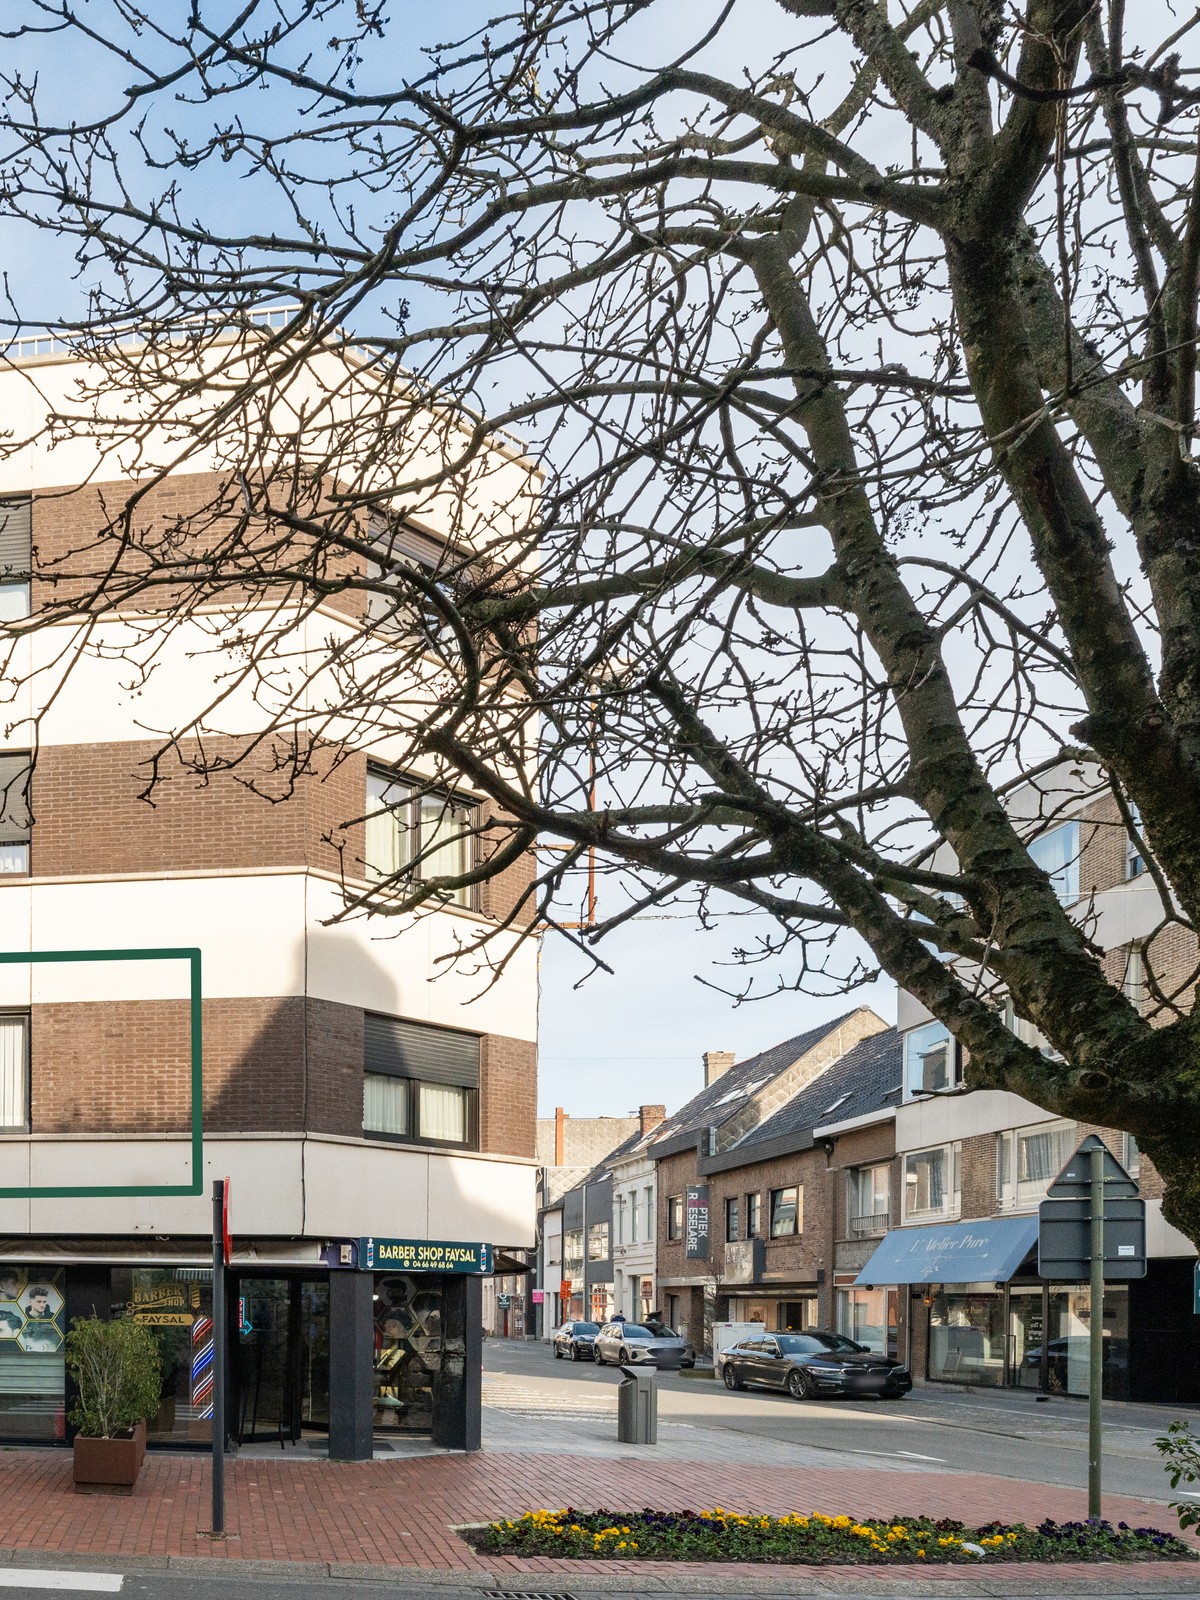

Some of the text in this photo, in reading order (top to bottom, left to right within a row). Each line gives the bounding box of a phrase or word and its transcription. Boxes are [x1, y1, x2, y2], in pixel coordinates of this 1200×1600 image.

[688, 1192, 699, 1251] ROESELARE
[698, 1200, 709, 1238] OPTIEK
[958, 1234, 990, 1249] Pure
[379, 1244, 476, 1263] BARBER SHOP FAYSAL
[421, 1260, 429, 1268] 66
[429, 1260, 438, 1269] 49
[437, 1261, 446, 1269] 68
[445, 1261, 454, 1269] 64
[134, 1286, 182, 1302] BARBER
[163, 1298, 185, 1307] SHOP
[142, 1315, 185, 1324] FAYSAL
